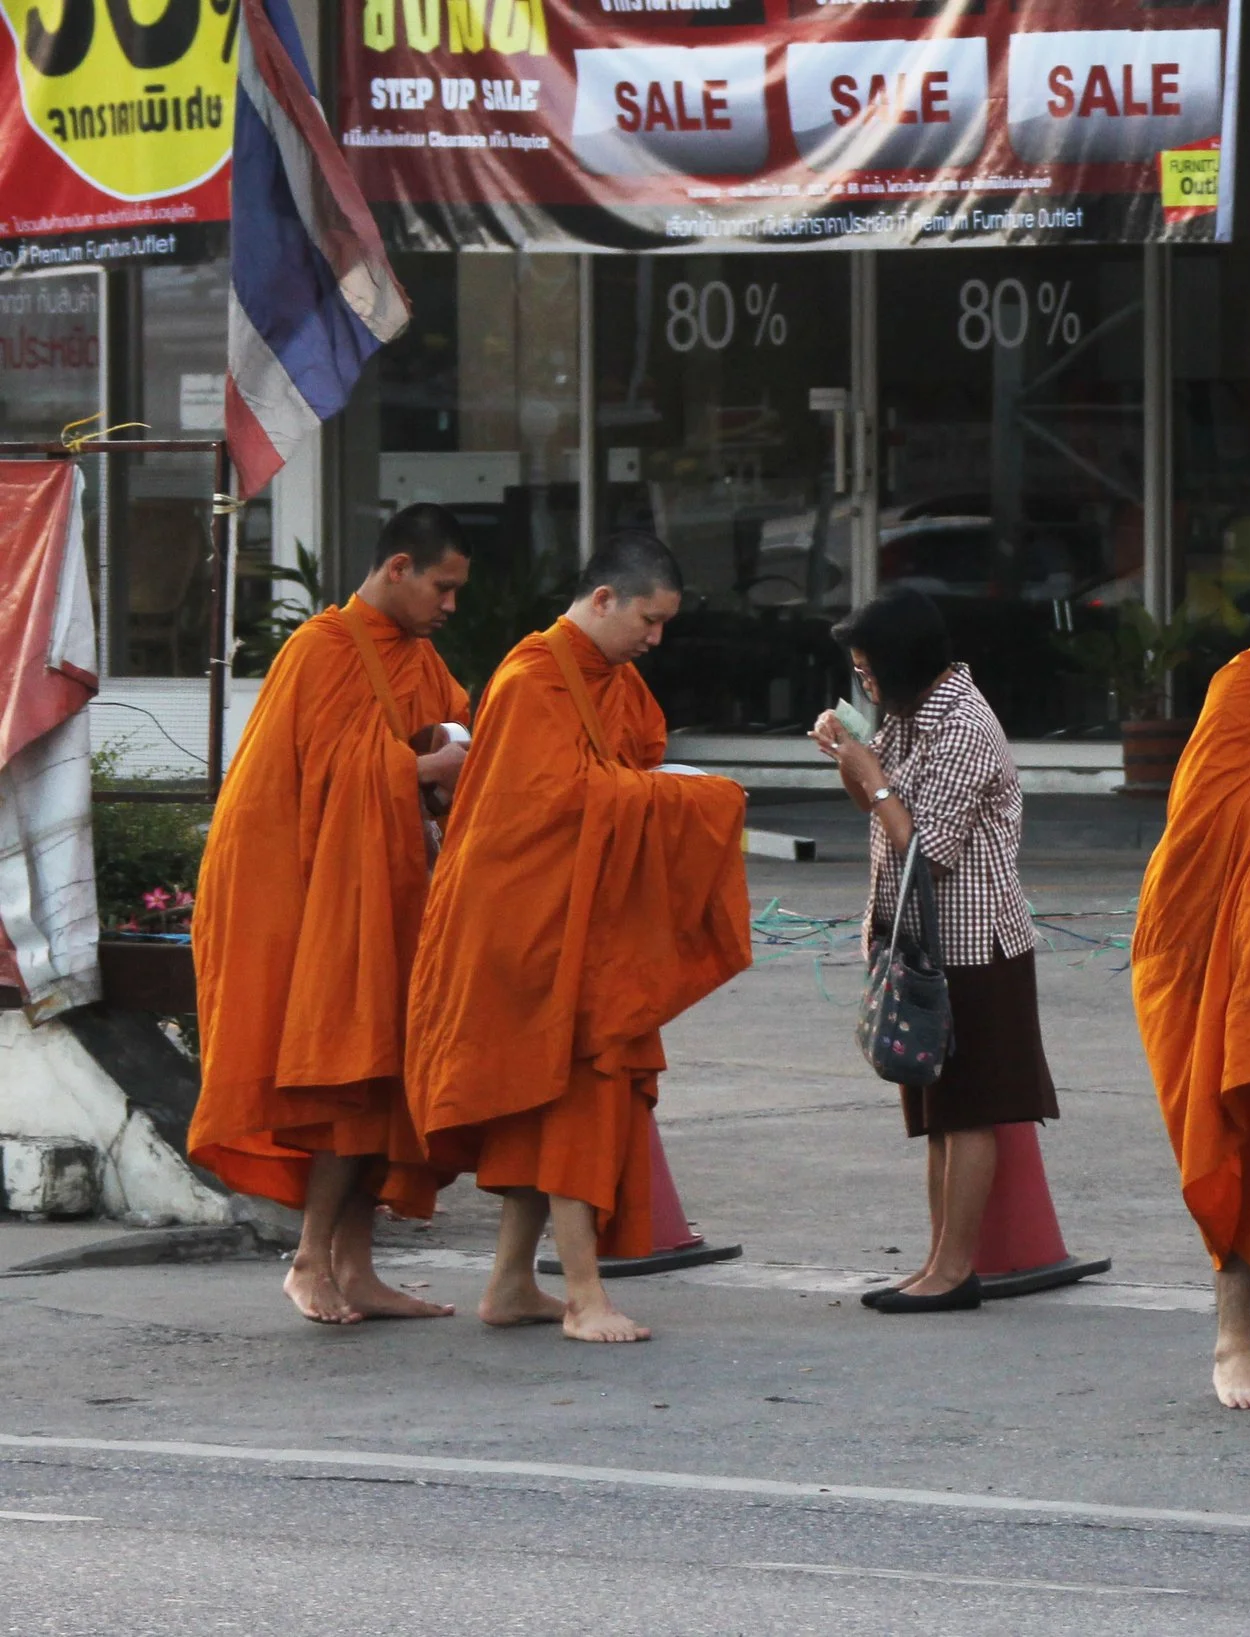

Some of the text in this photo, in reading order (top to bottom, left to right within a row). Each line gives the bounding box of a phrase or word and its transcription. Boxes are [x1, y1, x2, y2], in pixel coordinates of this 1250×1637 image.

[370, 77, 541, 112] STEP UP SALE
[614, 78, 733, 134] SALE
[830, 70, 951, 127] SALE
[1047, 62, 1181, 119] SALE
[913, 210, 969, 231] Premium
[973, 208, 1034, 230] Furniture
[1038, 207, 1084, 229] Outlet
[31, 242, 83, 264] Premium
[665, 280, 787, 352] 80%
[958, 277, 1081, 351] 80%
